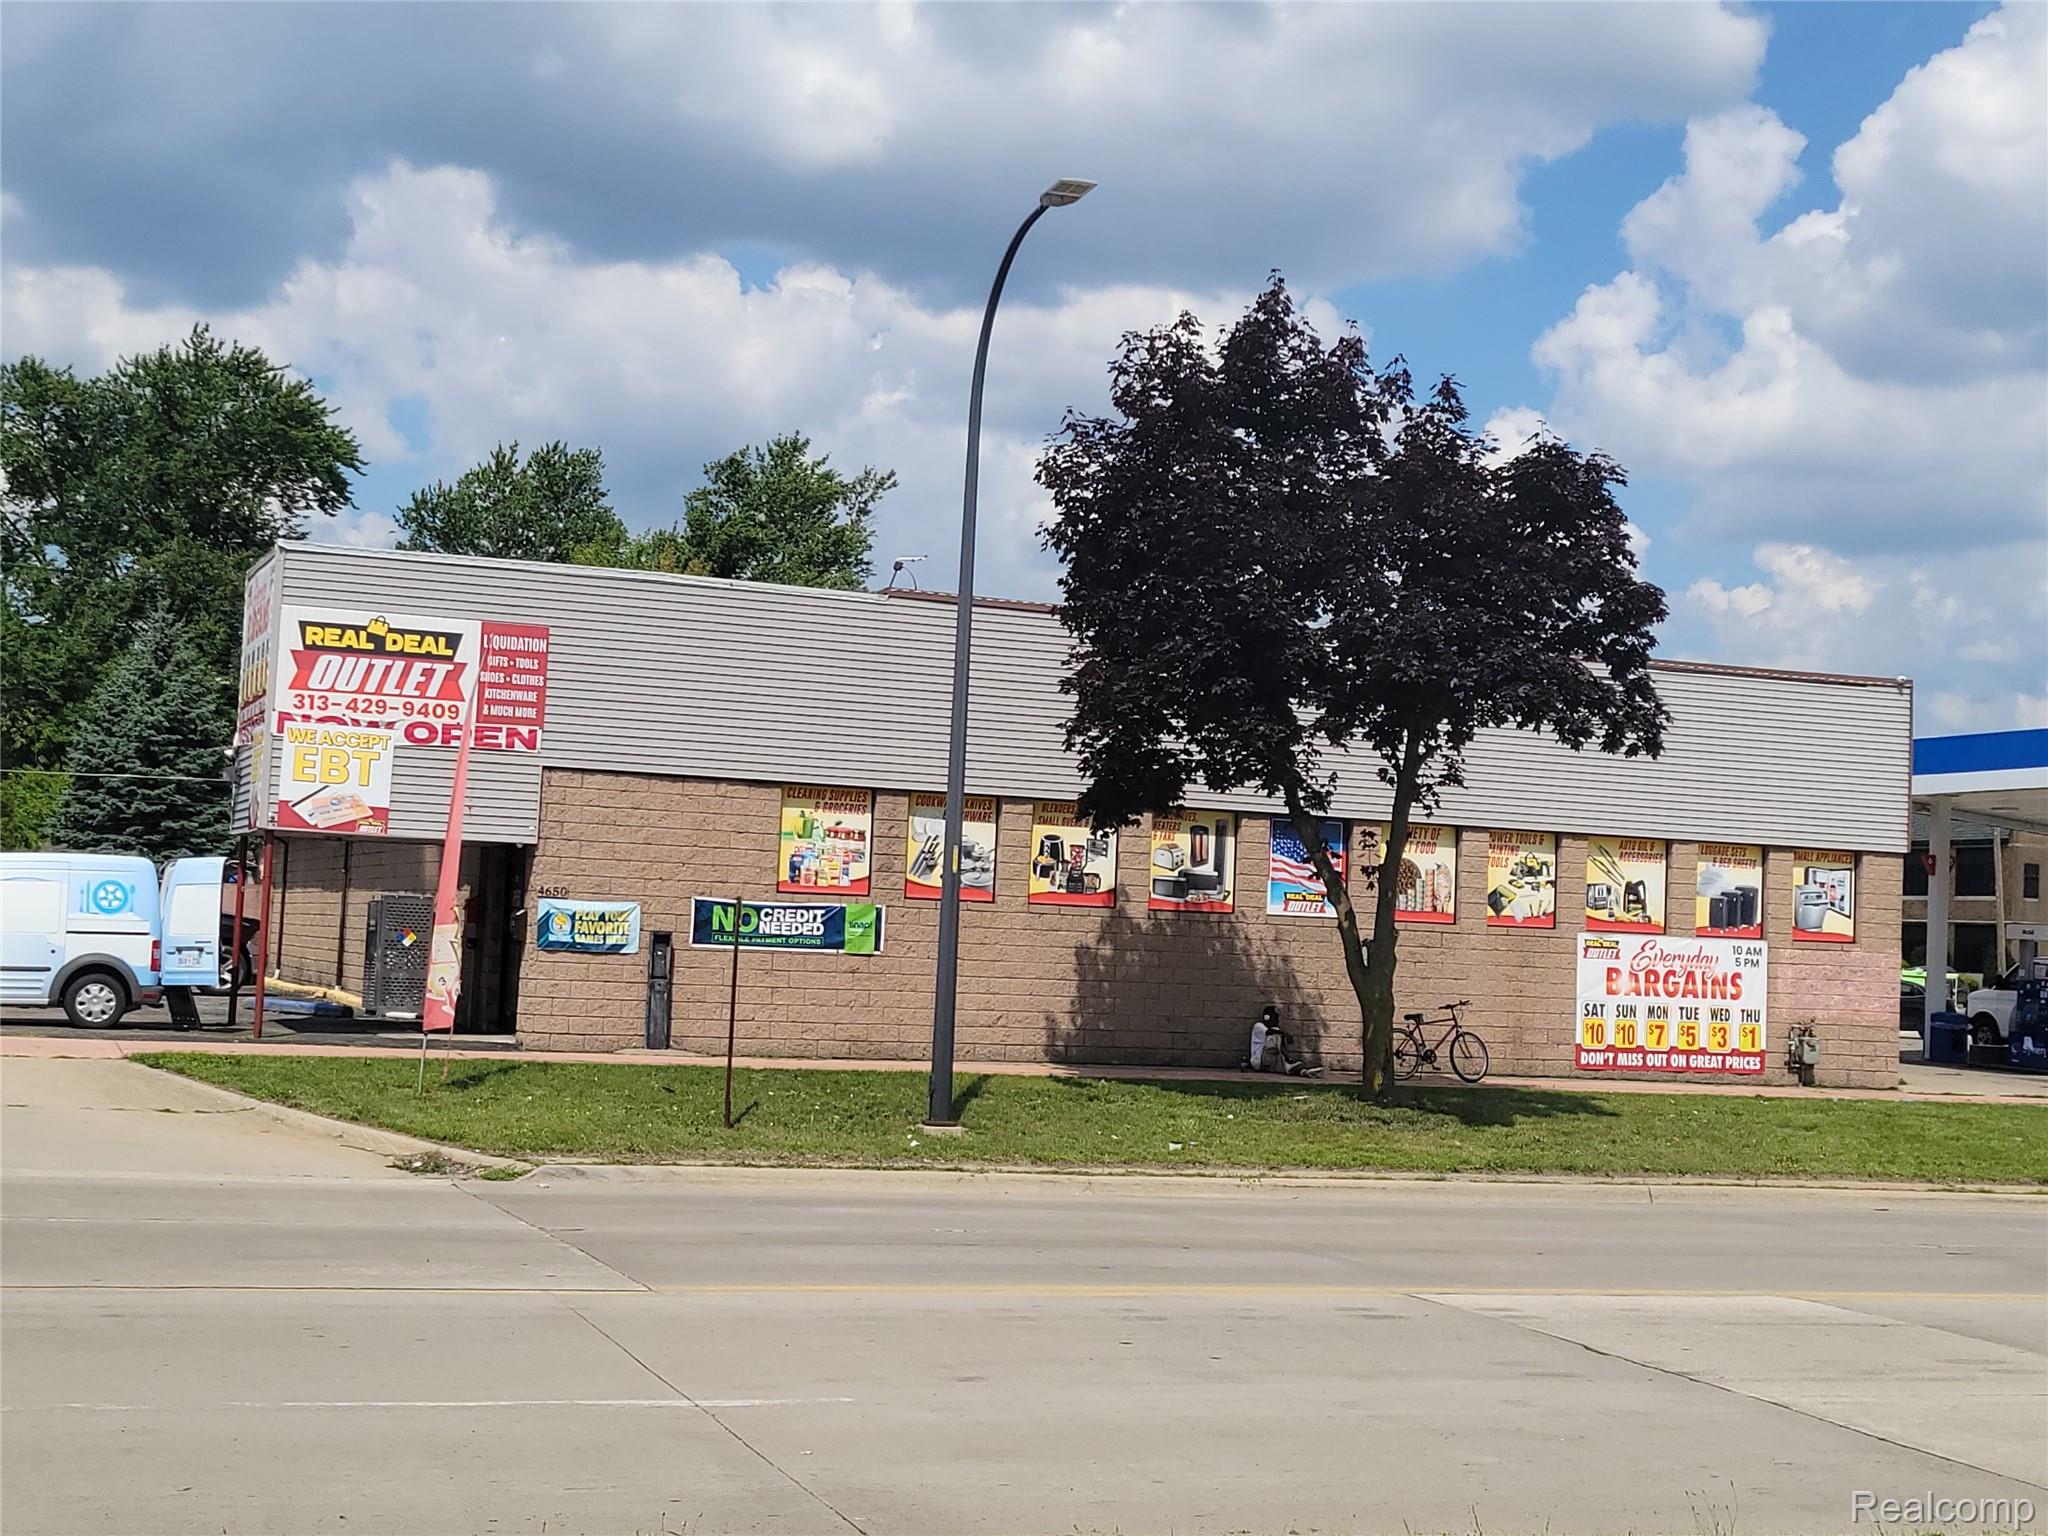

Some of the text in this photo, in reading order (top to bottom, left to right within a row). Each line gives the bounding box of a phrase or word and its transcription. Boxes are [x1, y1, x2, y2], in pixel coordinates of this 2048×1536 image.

[305, 626, 454, 656] REAL DEAL
[487, 656, 539, 670] GIFTS TOOLS
[307, 655, 455, 697] OUTLET
[480, 671, 544, 686] SHOES CLOTHES
[485, 688, 538, 702] KITCHENWARE
[292, 694, 460, 720] 313-429-9409
[482, 704, 537, 718] & MUCH MORE
[287, 728, 391, 750] WE ACCEPT
[404, 721, 538, 751] OPEN
[292, 745, 381, 787] EBT
[829, 789, 868, 802] SUPPLIES
[1415, 841, 1437, 854] FOOD
[537, 886, 568, 897] 4650
[711, 904, 826, 933] NO CREDIT
[574, 920, 630, 935] FAVORITE
[758, 922, 825, 936] NEEDED
[714, 935, 750, 943] FLEXBLE
[1630, 939, 1719, 979] Everyday
[1732, 945, 1762, 957] 10 AM
[1735, 957, 1760, 968] 5 PM
[1605, 967, 1743, 1001] BARGAINS
[1583, 1003, 1760, 1023] SAT SUN MON TUE WED THU
[1585, 1023, 1756, 1049] $10 $10 $7 $5 $3 $1
[1580, 1051, 1761, 1070] DON'T MISS OUT ON GREAT PRICES
